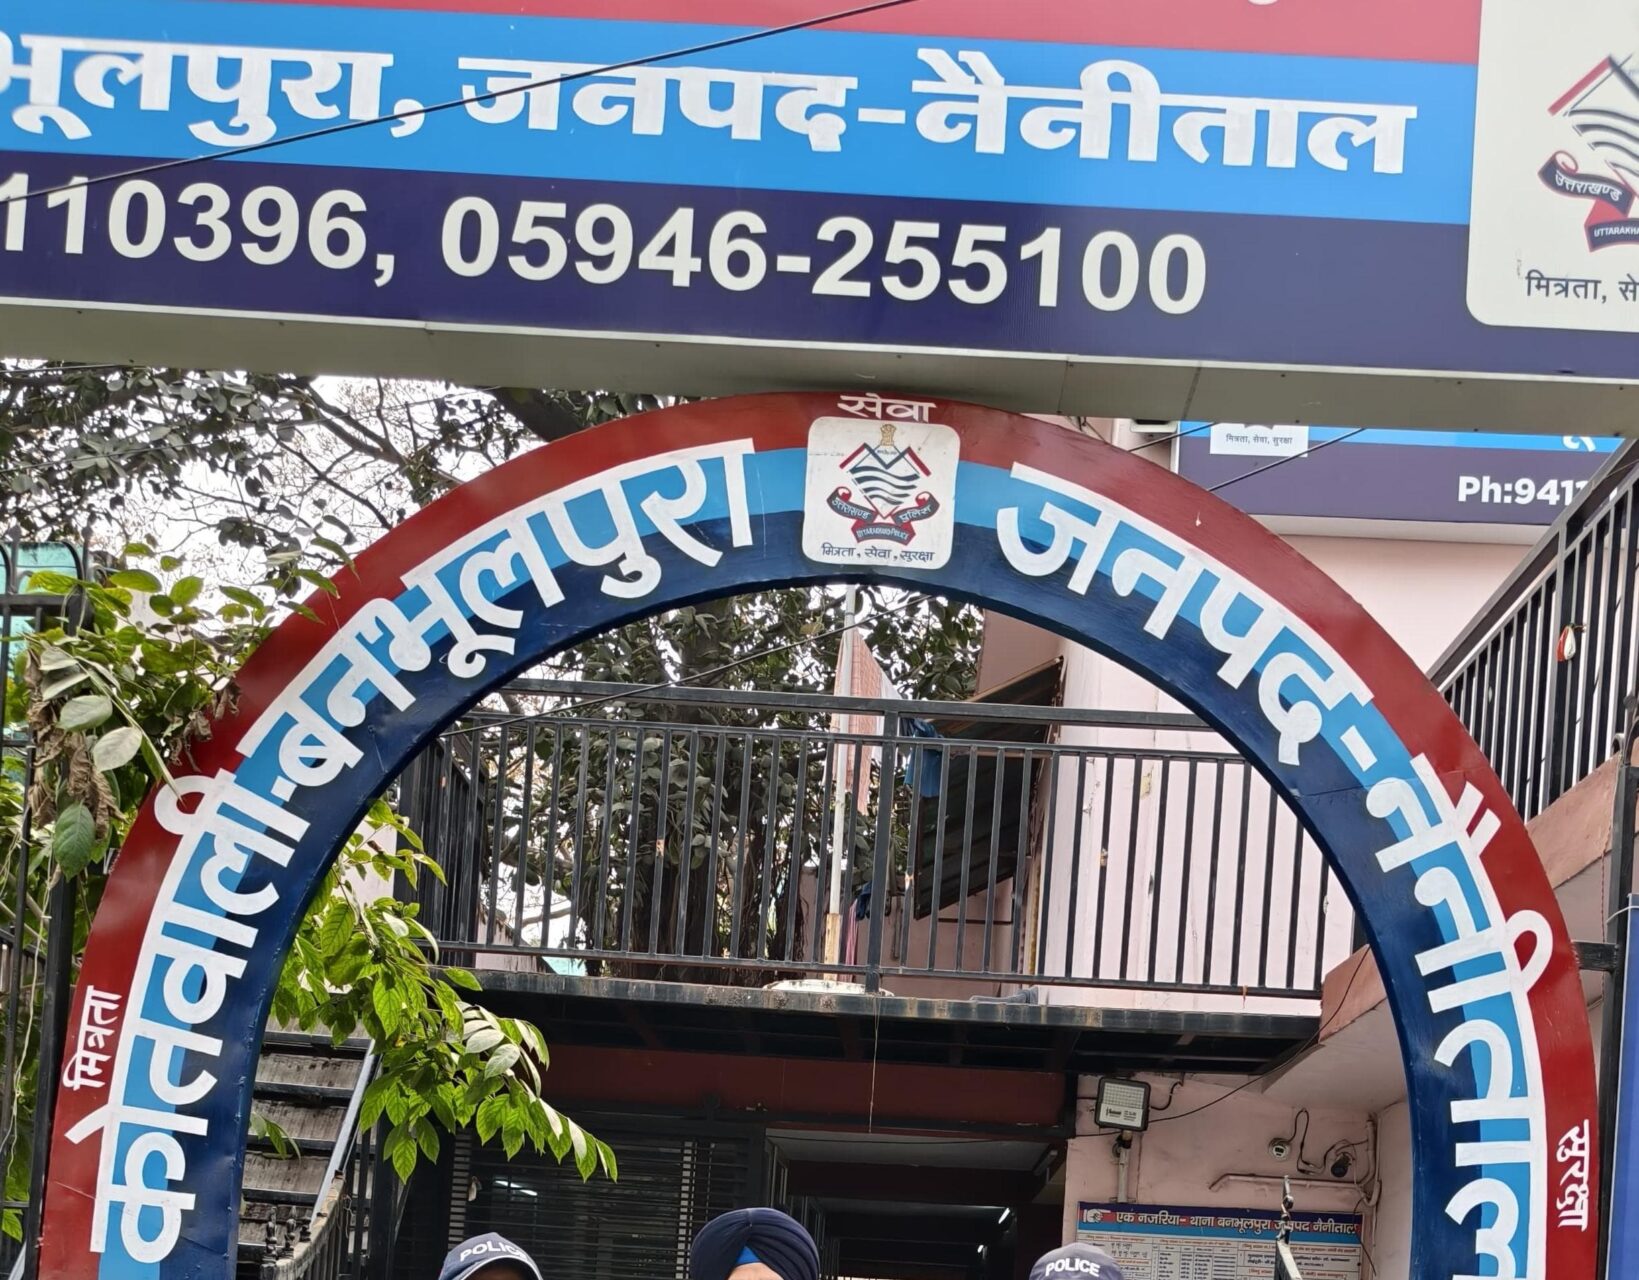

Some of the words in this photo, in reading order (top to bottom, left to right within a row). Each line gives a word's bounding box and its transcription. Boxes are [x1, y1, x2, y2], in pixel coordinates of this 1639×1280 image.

[441, 196, 1207, 315] 05946-255100
[1526, 268, 1607, 304] मित्रता,
[837, 392, 937, 423] सेवा
[900, 550, 935, 563] सुरक्षा
[62, 985, 122, 1091] मित्रता
[1556, 1119, 1589, 1232] सुरक्षा
[1045, 1258, 1100, 1277] POLICE
